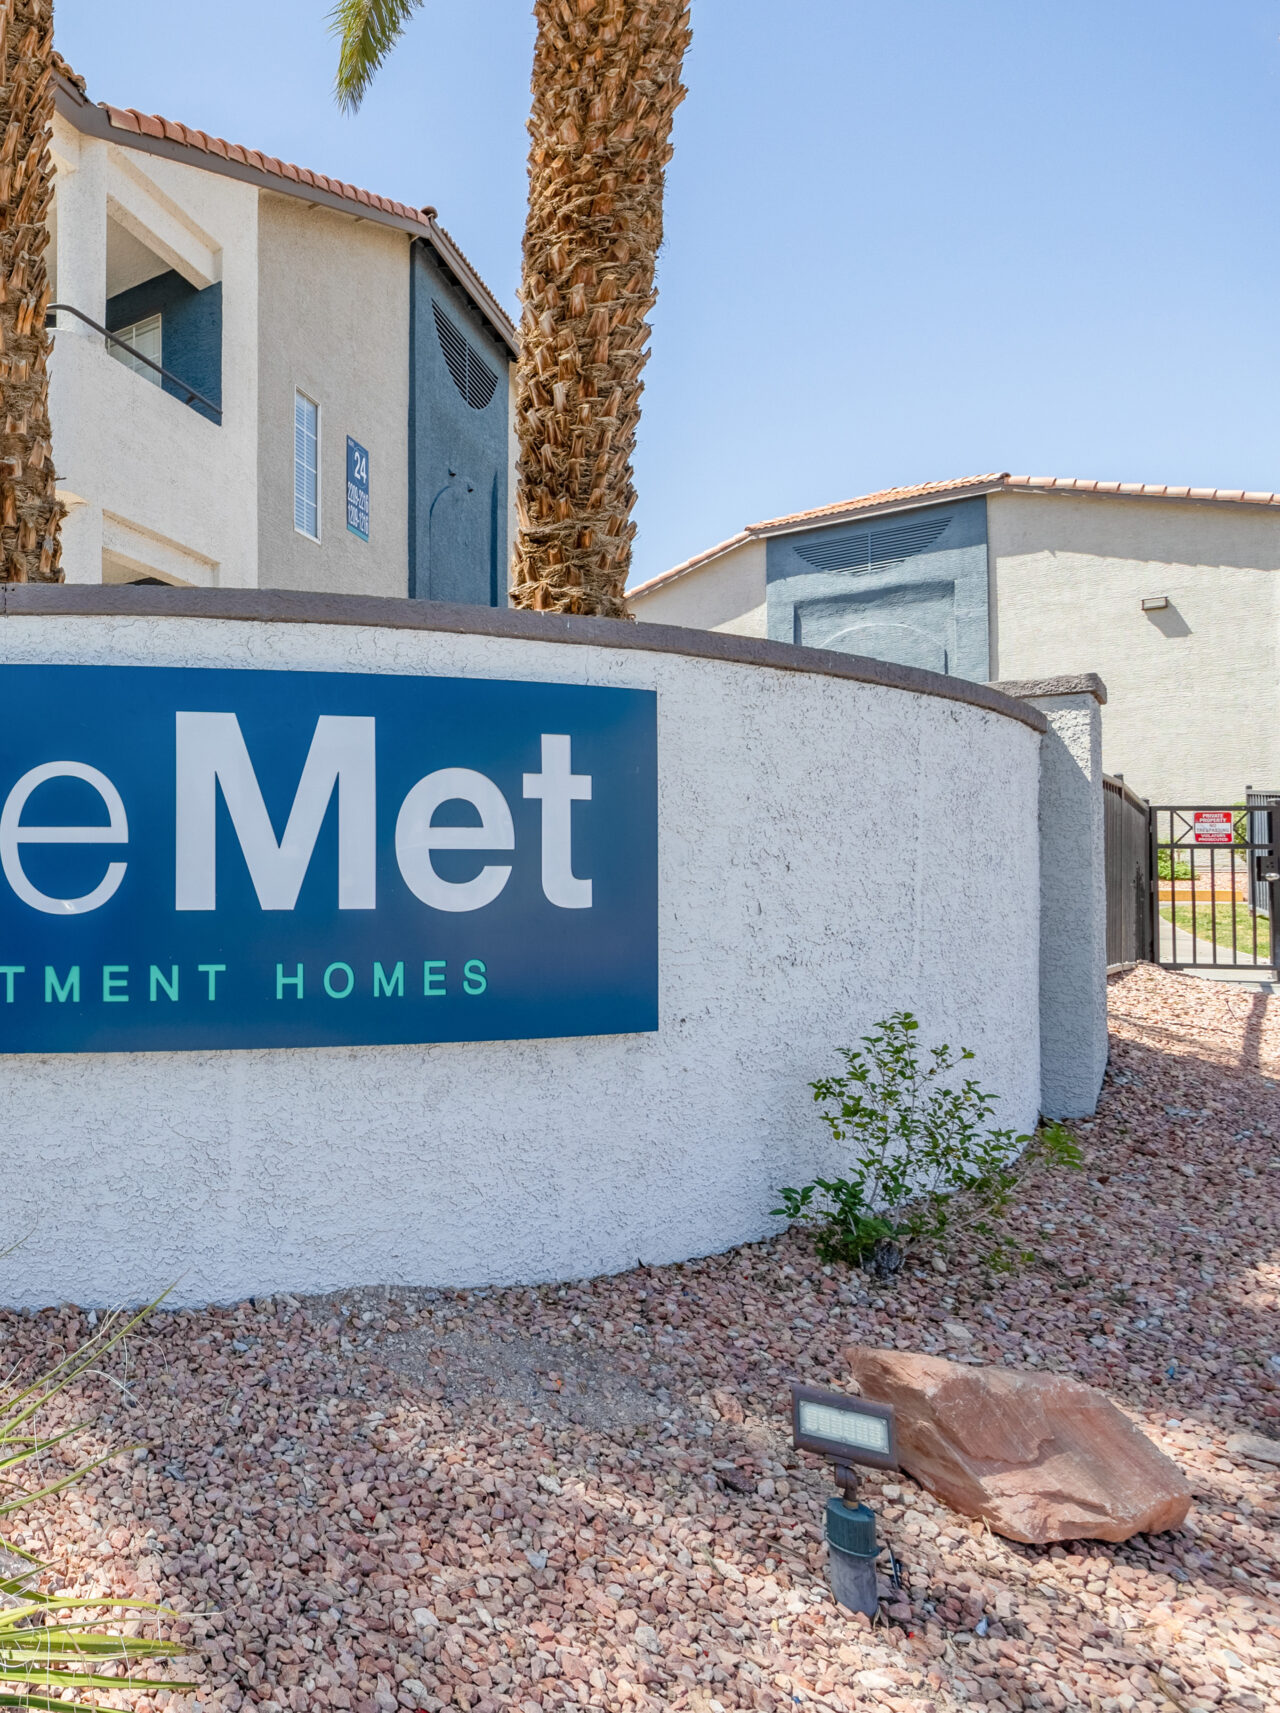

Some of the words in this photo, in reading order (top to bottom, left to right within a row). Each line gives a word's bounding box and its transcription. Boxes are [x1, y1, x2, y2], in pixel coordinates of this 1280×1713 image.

[354, 451, 367, 484] 24
[175, 711, 593, 913] Met
[276, 959, 487, 1000] HOMES
